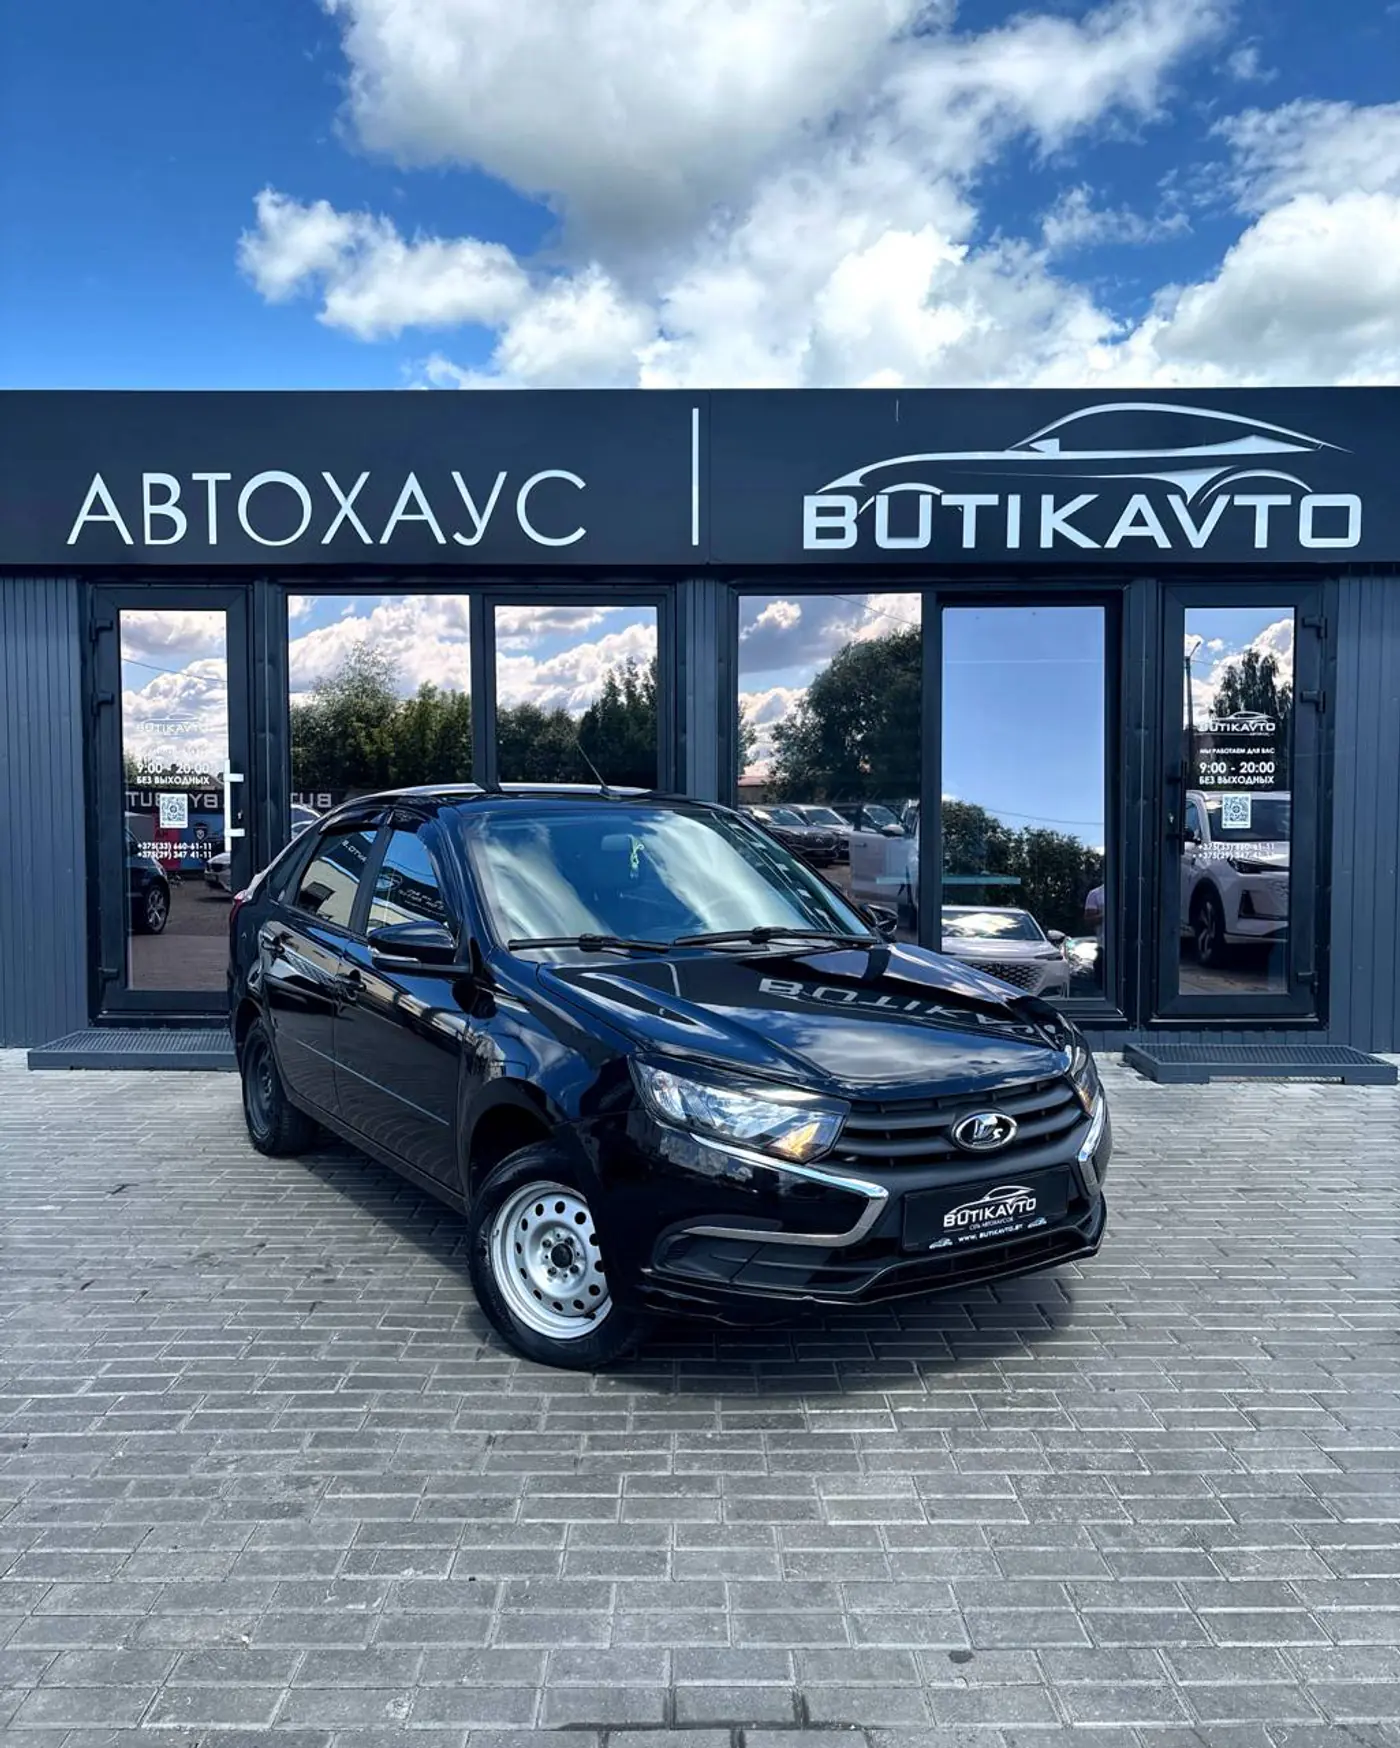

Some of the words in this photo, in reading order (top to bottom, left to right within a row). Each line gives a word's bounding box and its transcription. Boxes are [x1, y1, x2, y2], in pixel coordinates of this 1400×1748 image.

[66, 470, 588, 547] АВТОХАУС
[803, 493, 1363, 550] BUTIKAVTO
[137, 762, 163, 774] 9:00
[1199, 761, 1227, 774] 9:00
[1239, 761, 1275, 774] 20:00
[137, 776, 152, 784] БЕЗ
[155, 776, 209, 785] ВЫХОДНЫХ
[1199, 776, 1215, 785] БЕЗ
[1217, 776, 1274, 785] ВЫХОДНЫХ
[943, 1198, 1037, 1229] BUTIKAVTO
